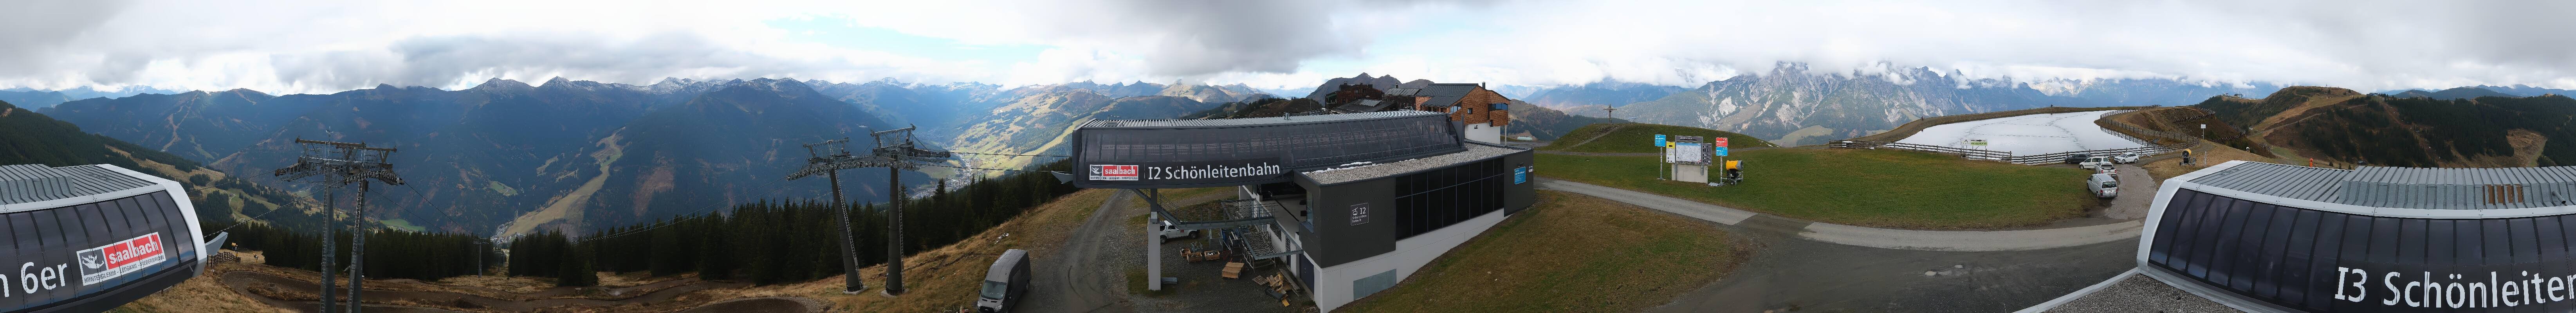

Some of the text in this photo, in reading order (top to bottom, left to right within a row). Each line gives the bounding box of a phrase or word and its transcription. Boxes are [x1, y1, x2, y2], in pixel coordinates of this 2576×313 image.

[1105, 165, 1135, 174] saalbach
[1148, 162, 1280, 180] I2 Schönleitenbahn
[109, 235, 159, 264] saalbach
[21, 262, 67, 294] 6er
[2335, 266, 2367, 302] I3
